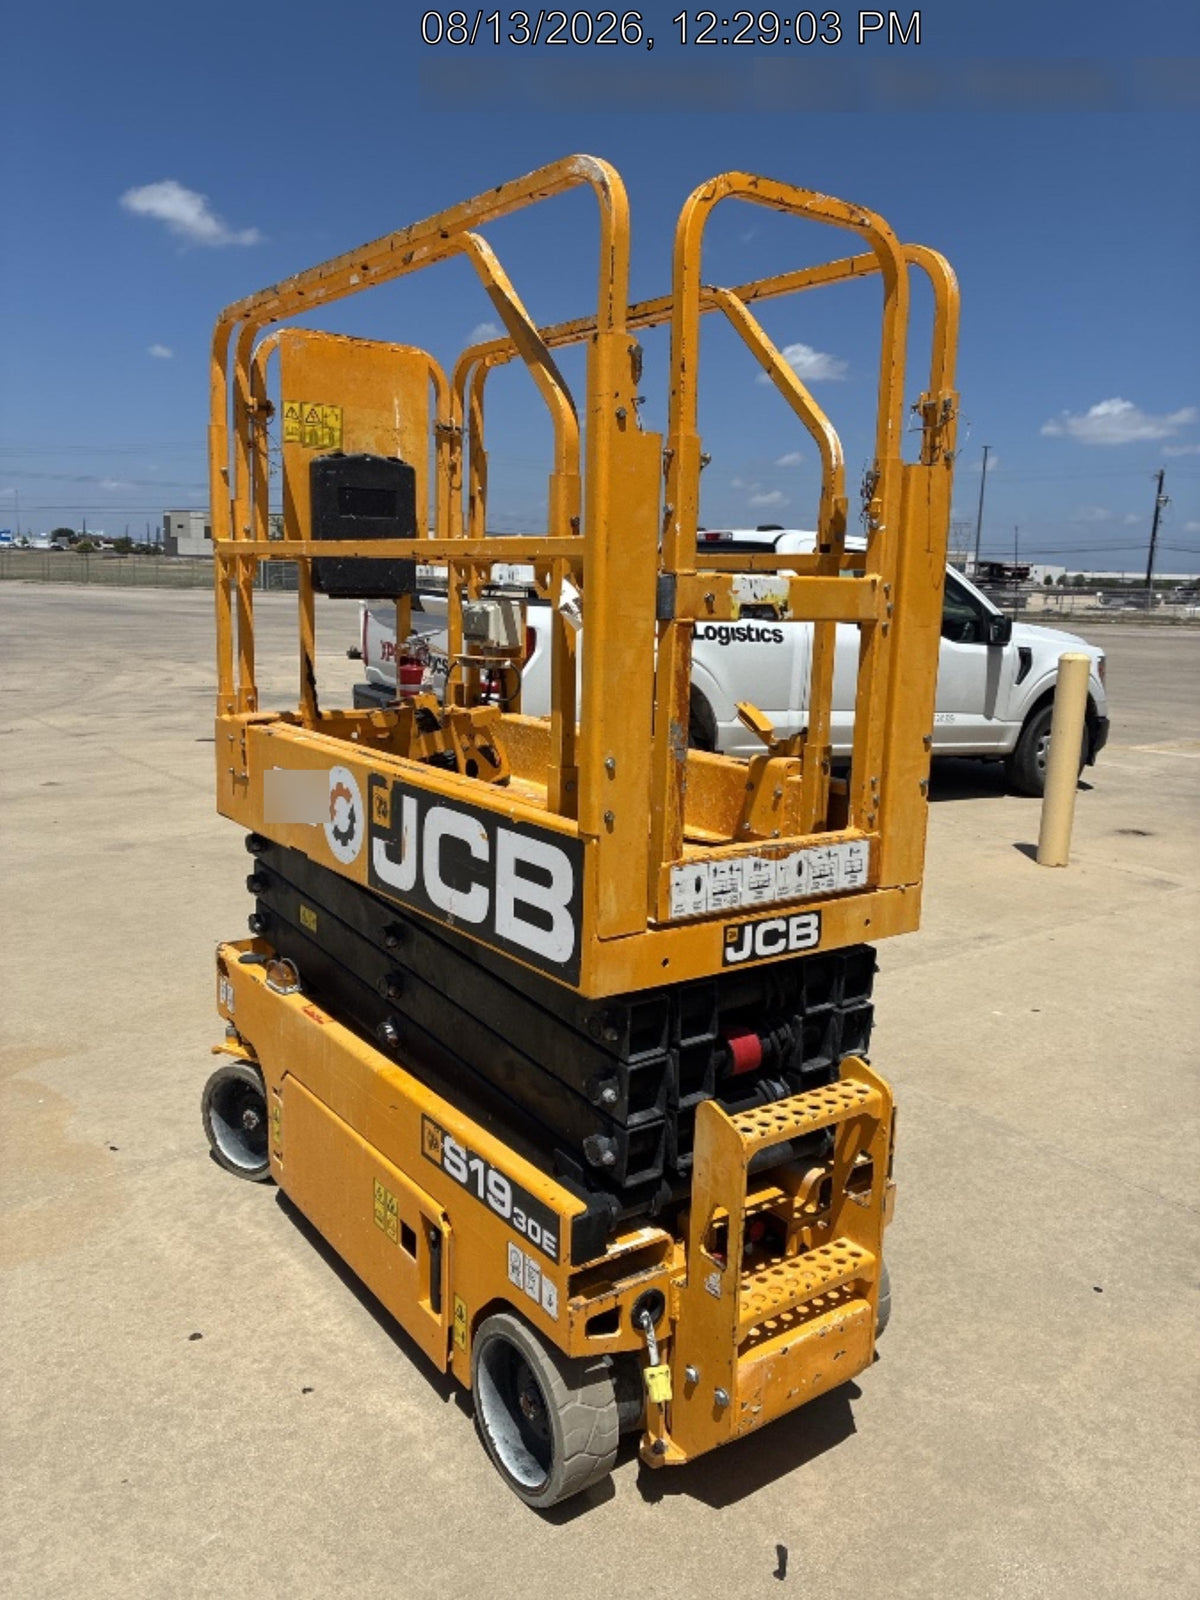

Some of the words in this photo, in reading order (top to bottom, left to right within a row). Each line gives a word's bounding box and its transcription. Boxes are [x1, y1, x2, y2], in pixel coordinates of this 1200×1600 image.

[692, 623, 785, 646] Logistics
[372, 794, 575, 963] JCB
[725, 913, 819, 962] JCB
